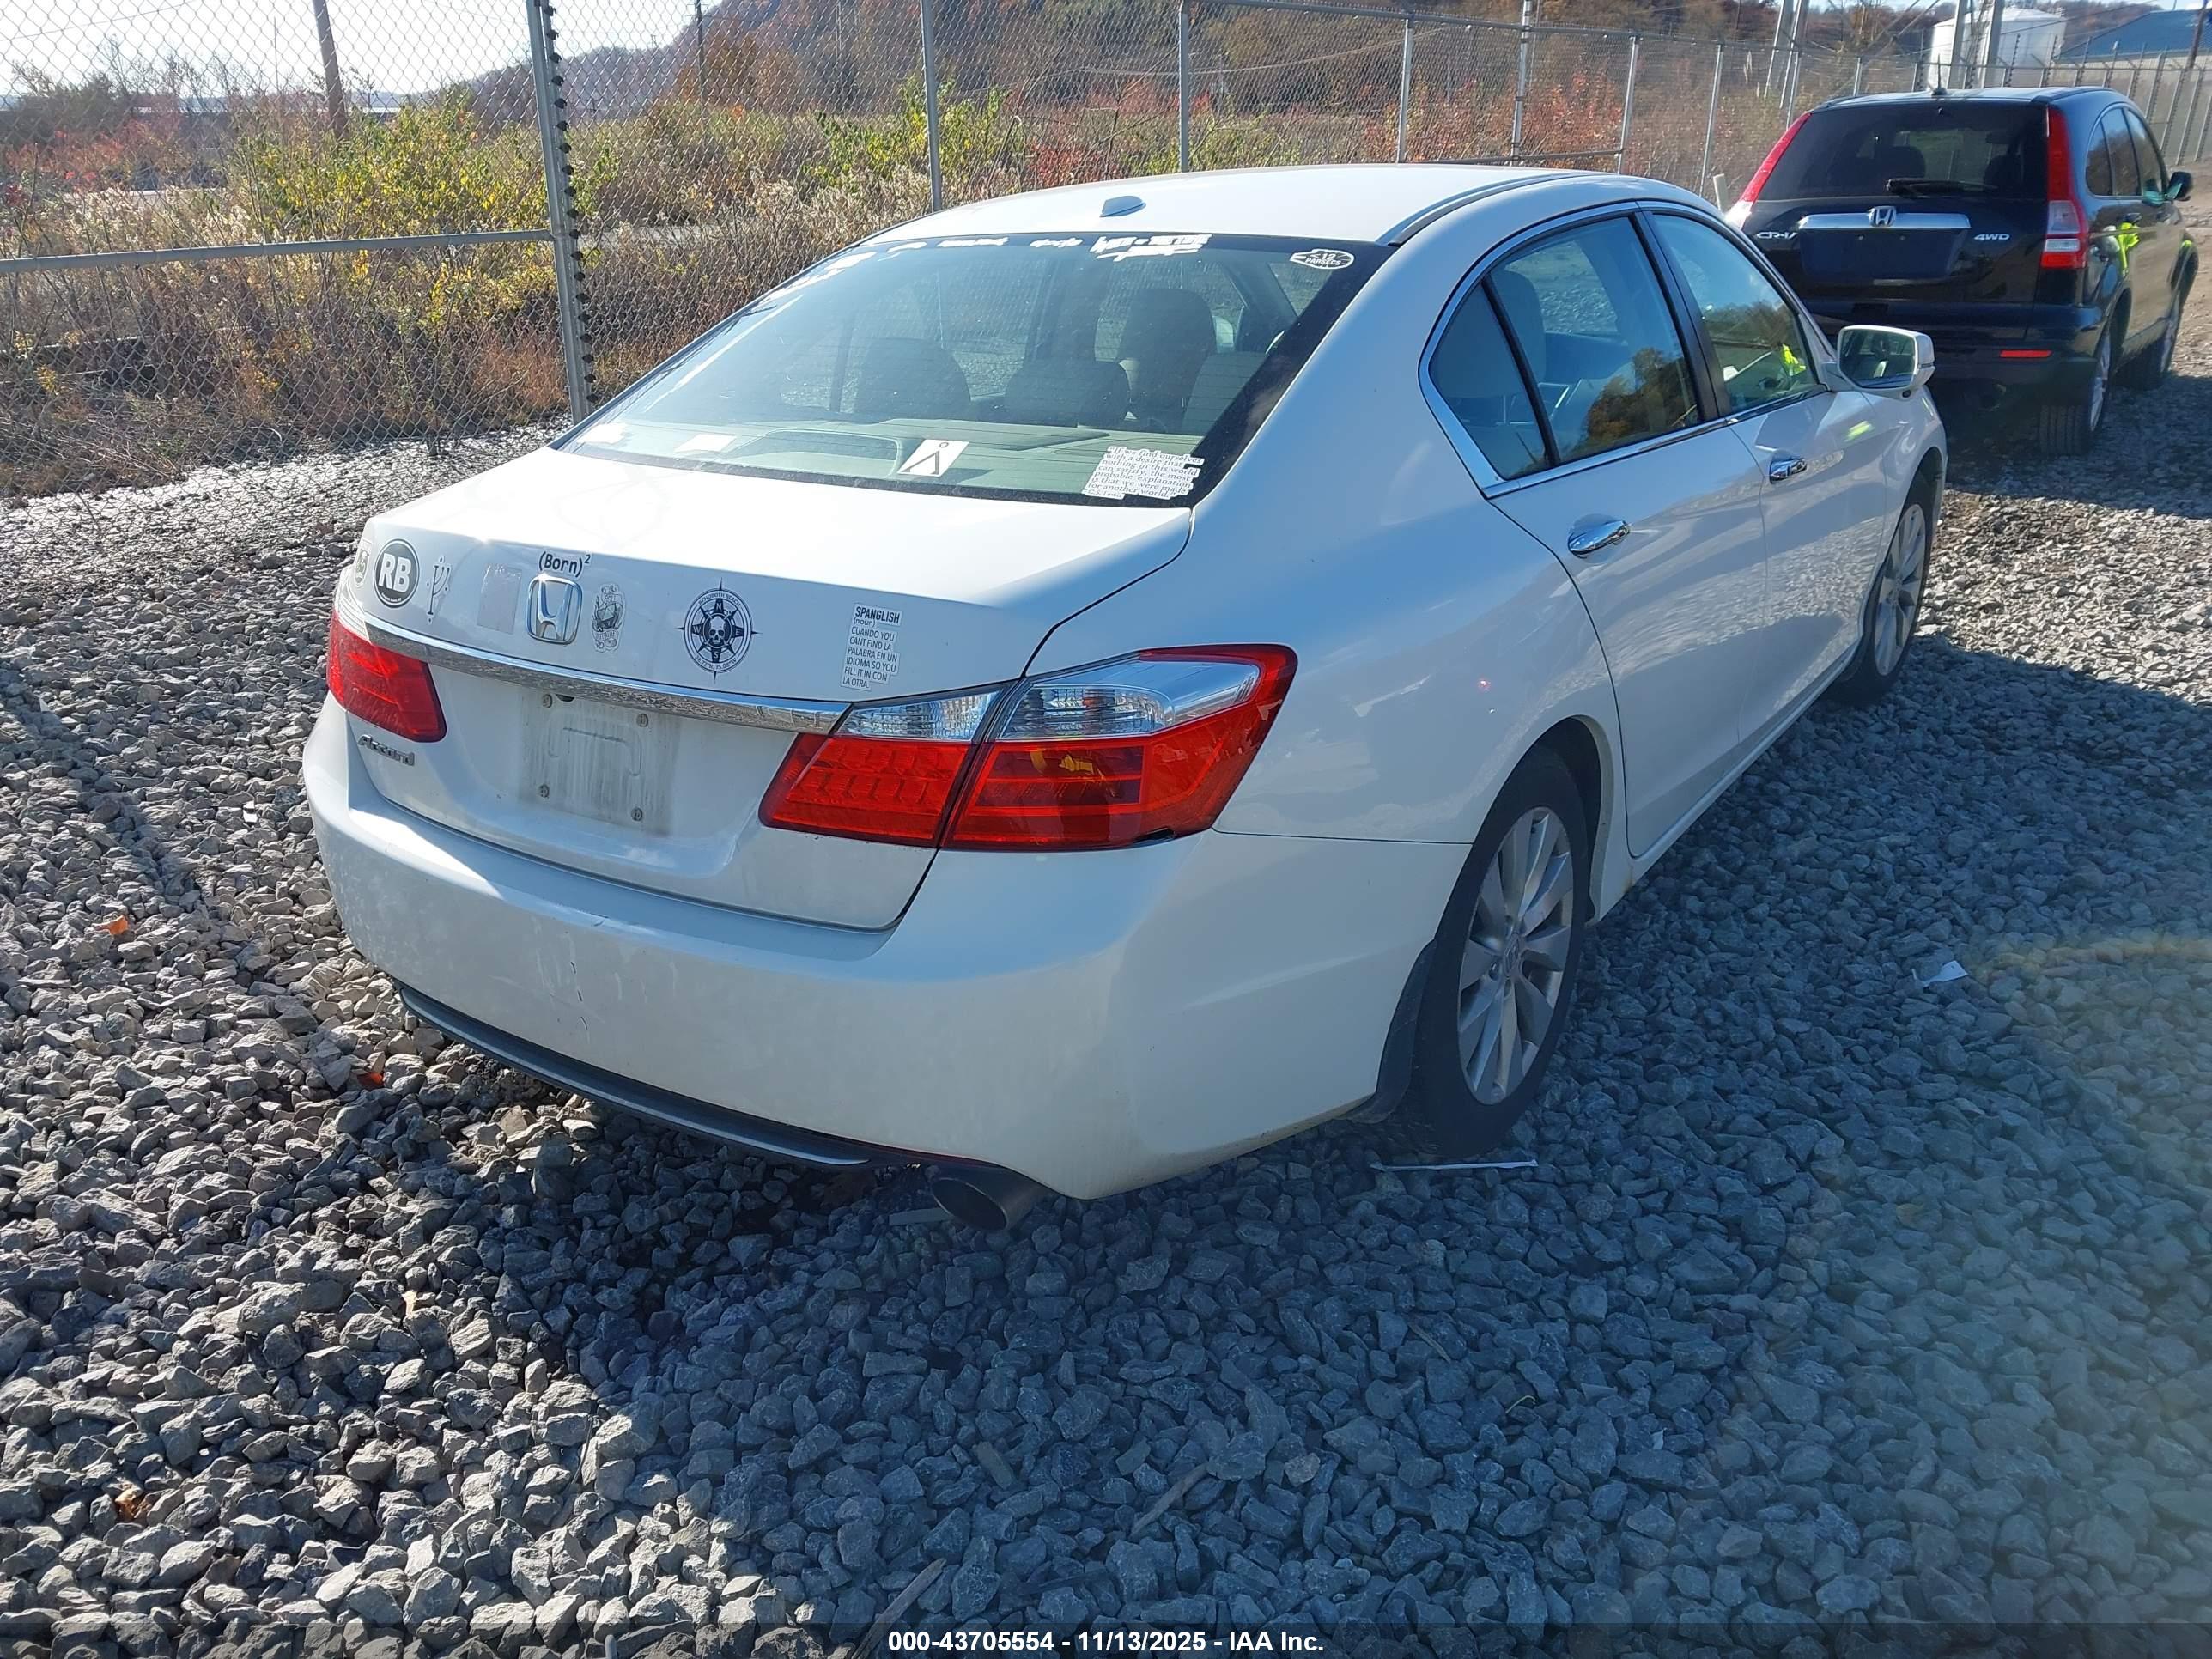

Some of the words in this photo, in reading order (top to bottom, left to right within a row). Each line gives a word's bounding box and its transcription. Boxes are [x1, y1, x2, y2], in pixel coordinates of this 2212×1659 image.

[1102, 459, 1137, 469] nothing
[1159, 454, 1201, 463] ourselves
[1103, 484, 1138, 493] another
[1138, 476, 1191, 488] explanation
[378, 552, 412, 592] RB
[855, 606, 900, 623] SPANGLISH
[854, 617, 876, 628] (noun)
[852, 627, 879, 639] CUANDO
[881, 633, 895, 641] YOU
[850, 637, 866, 647] CANT
[867, 640, 883, 650] FIND
[848, 647, 875, 659] PALABRA
[888, 654, 897, 663] UN
[847, 657, 871, 668] IDIOMA
[872, 661, 881, 670] SO
[883, 663, 896, 673] YOU
[845, 667, 857, 676] FILL
[865, 670, 872, 679] IN
[873, 672, 888, 682] CON
[357, 733, 415, 767] Accord
